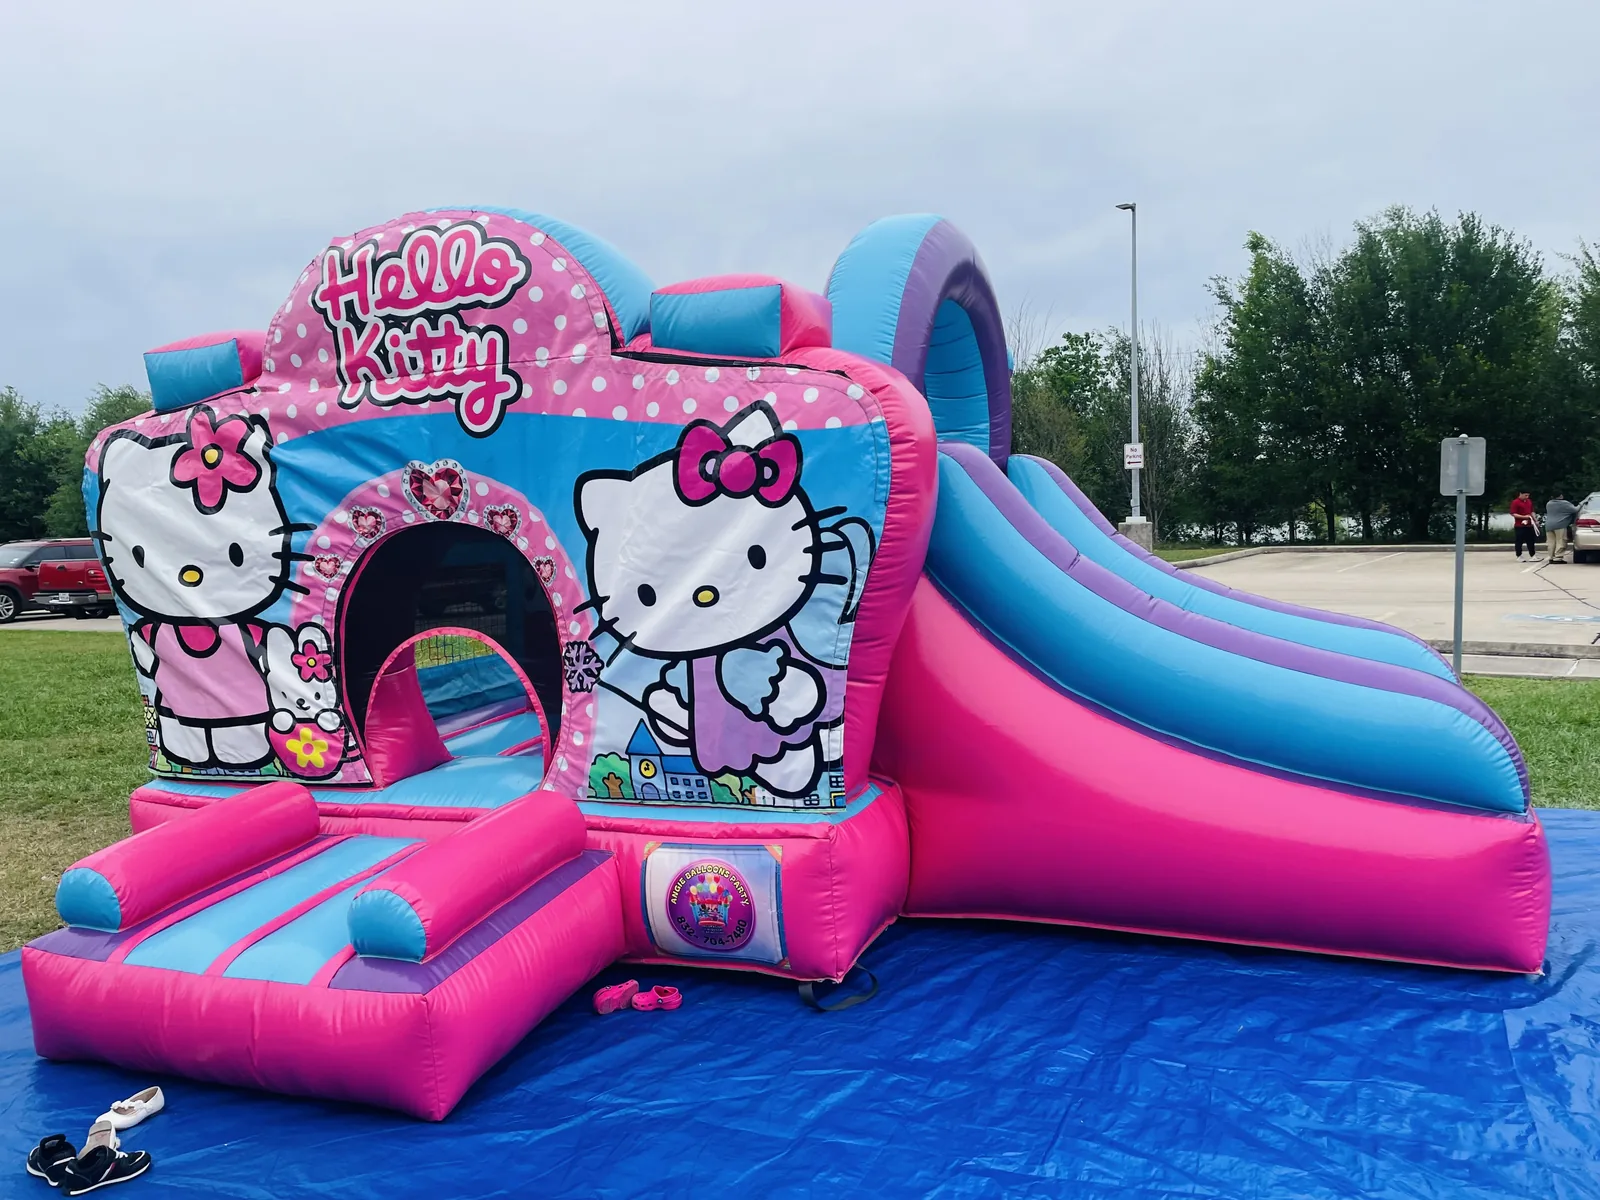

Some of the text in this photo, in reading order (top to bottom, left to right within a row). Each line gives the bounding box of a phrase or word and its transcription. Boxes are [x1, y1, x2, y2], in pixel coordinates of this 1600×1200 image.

[313, 222, 529, 323] Hello
[339, 316, 516, 431] Kitty
[670, 865, 750, 906] ANGIE BALLOONS PARTY
[677, 916, 747, 946] 832- 704-7480
